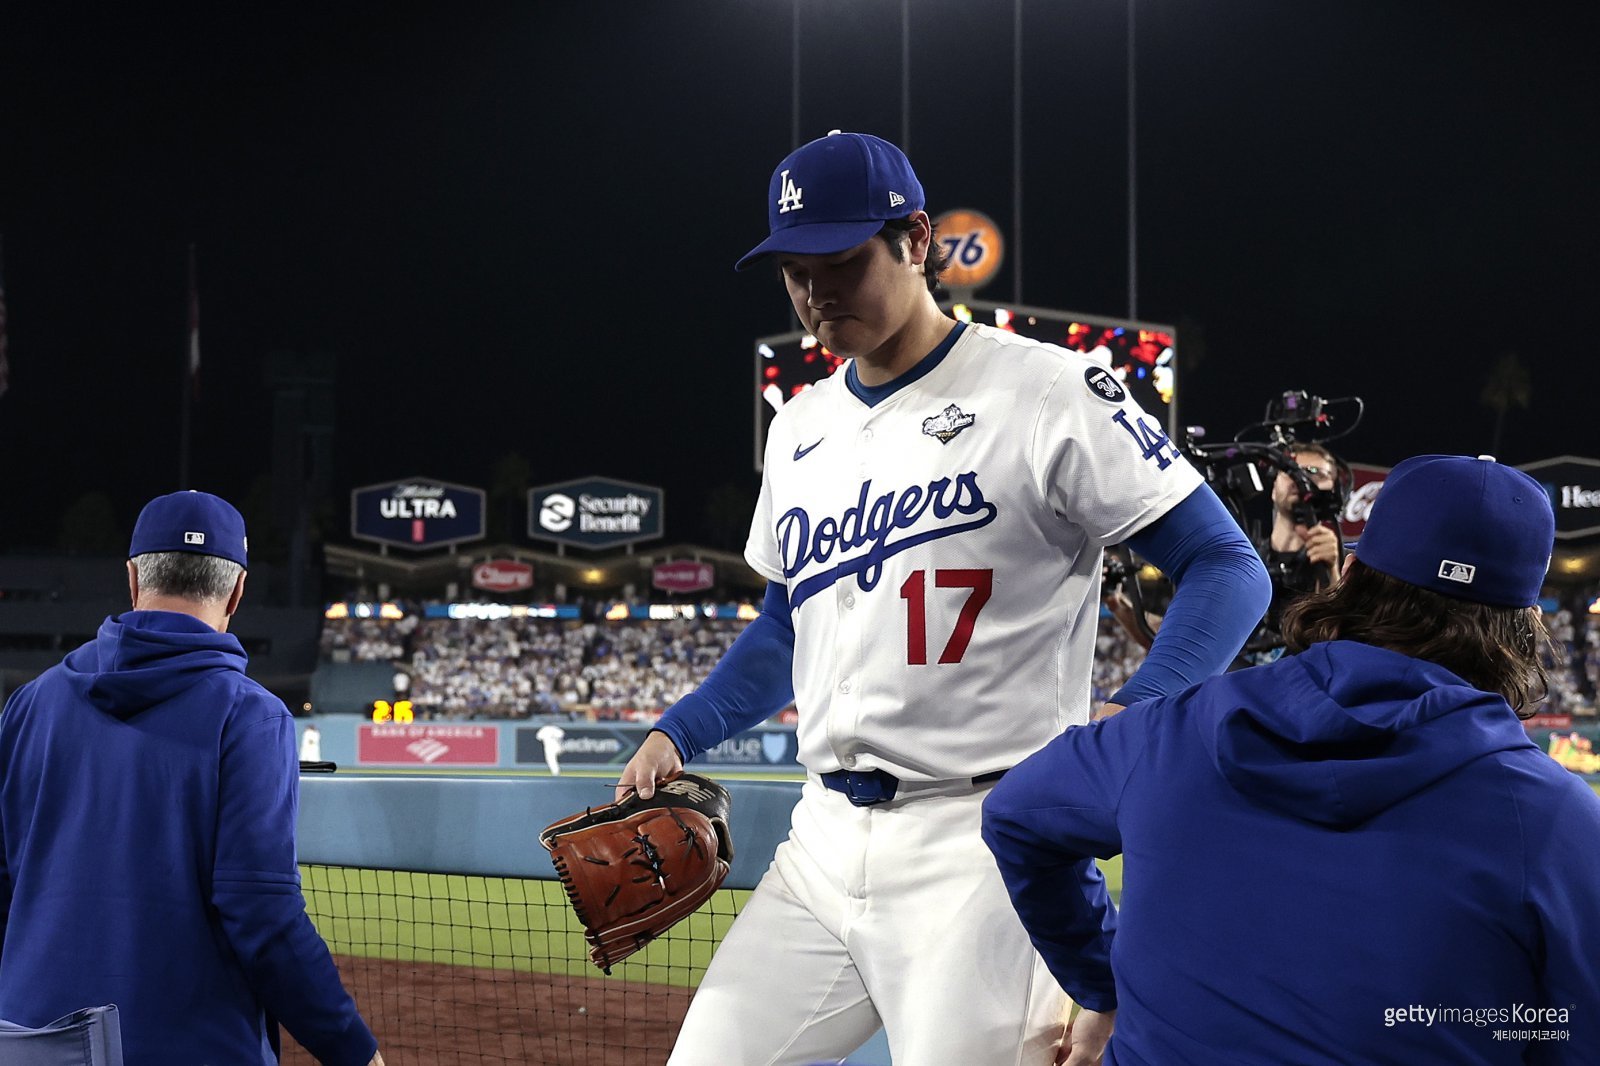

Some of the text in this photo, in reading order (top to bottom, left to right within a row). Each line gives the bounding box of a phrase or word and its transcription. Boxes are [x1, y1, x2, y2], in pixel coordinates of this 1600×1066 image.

[778, 169, 803, 214] LA
[941, 232, 984, 267] 76
[1096, 376, 1122, 398] 34
[1111, 408, 1181, 471] LA
[380, 498, 456, 519] ULTRA
[579, 493, 651, 517] Security
[580, 512, 641, 532] Benefit
[776, 471, 997, 593] Dodgers
[900, 568, 993, 665] 17
